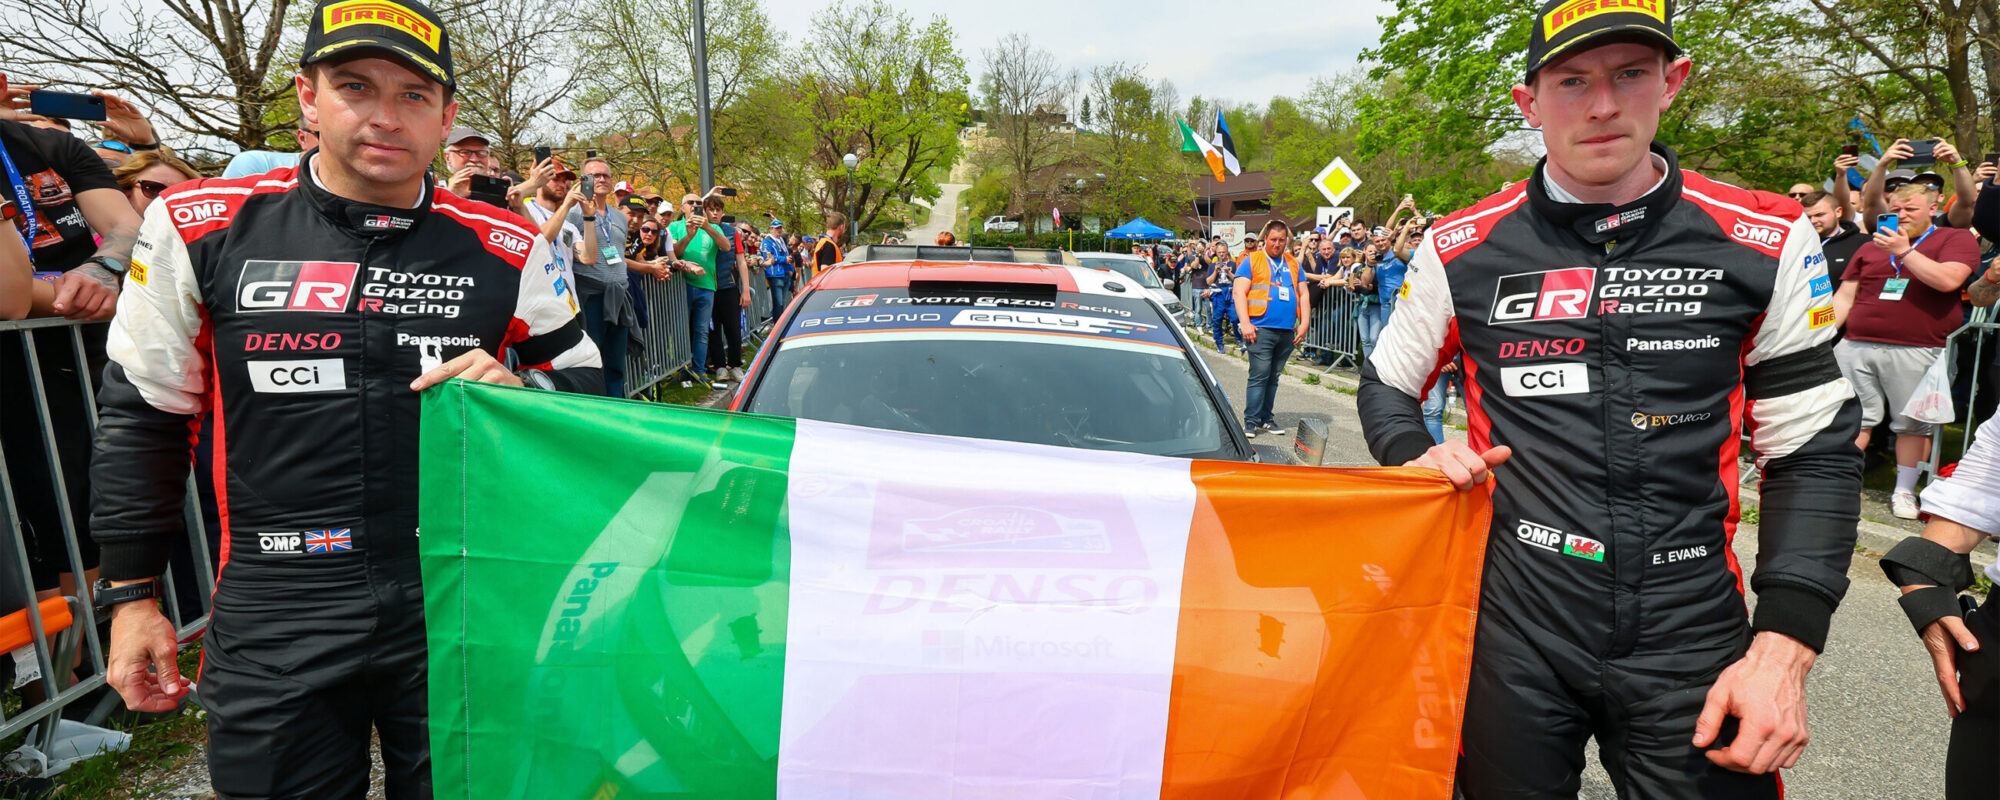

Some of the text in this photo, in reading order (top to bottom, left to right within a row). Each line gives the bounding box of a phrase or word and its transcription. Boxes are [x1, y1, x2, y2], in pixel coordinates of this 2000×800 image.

[331, 3, 431, 42] PIRELLI
[1552, 0, 1657, 30] PIRELLI
[15, 184, 33, 217] CROATIA
[28, 217, 36, 239] RALLY
[173, 203, 227, 223] OMP
[365, 219, 388, 228] GR
[1597, 219, 1619, 231] GR
[489, 231, 529, 252] OMP
[1437, 227, 1477, 248] OMP
[1733, 223, 1782, 245] OMP
[367, 267, 475, 287] TOYOTA
[1604, 267, 1724, 282] TOYOTA
[240, 280, 347, 308] GR
[362, 282, 465, 300] GAZOO
[1599, 283, 1709, 298] GAZOO
[1814, 279, 1831, 294] Asah
[357, 298, 460, 318] Racing
[834, 296, 1132, 317] GR TOYOTA GAZOO Racing
[1494, 289, 1587, 320] GR
[1598, 299, 1702, 316] Racing
[800, 313, 1080, 328] BEYOND RALLY
[245, 332, 342, 351] DENSO
[1499, 338, 1586, 359] DENSO
[1626, 334, 1720, 351] Panasonic
[260, 536, 301, 550] OMP
[1517, 524, 1560, 548] OMP
[1653, 545, 1707, 565] E. EVANS
[862, 574, 1159, 616] DENSO
[974, 631, 1112, 657] Microsoft
